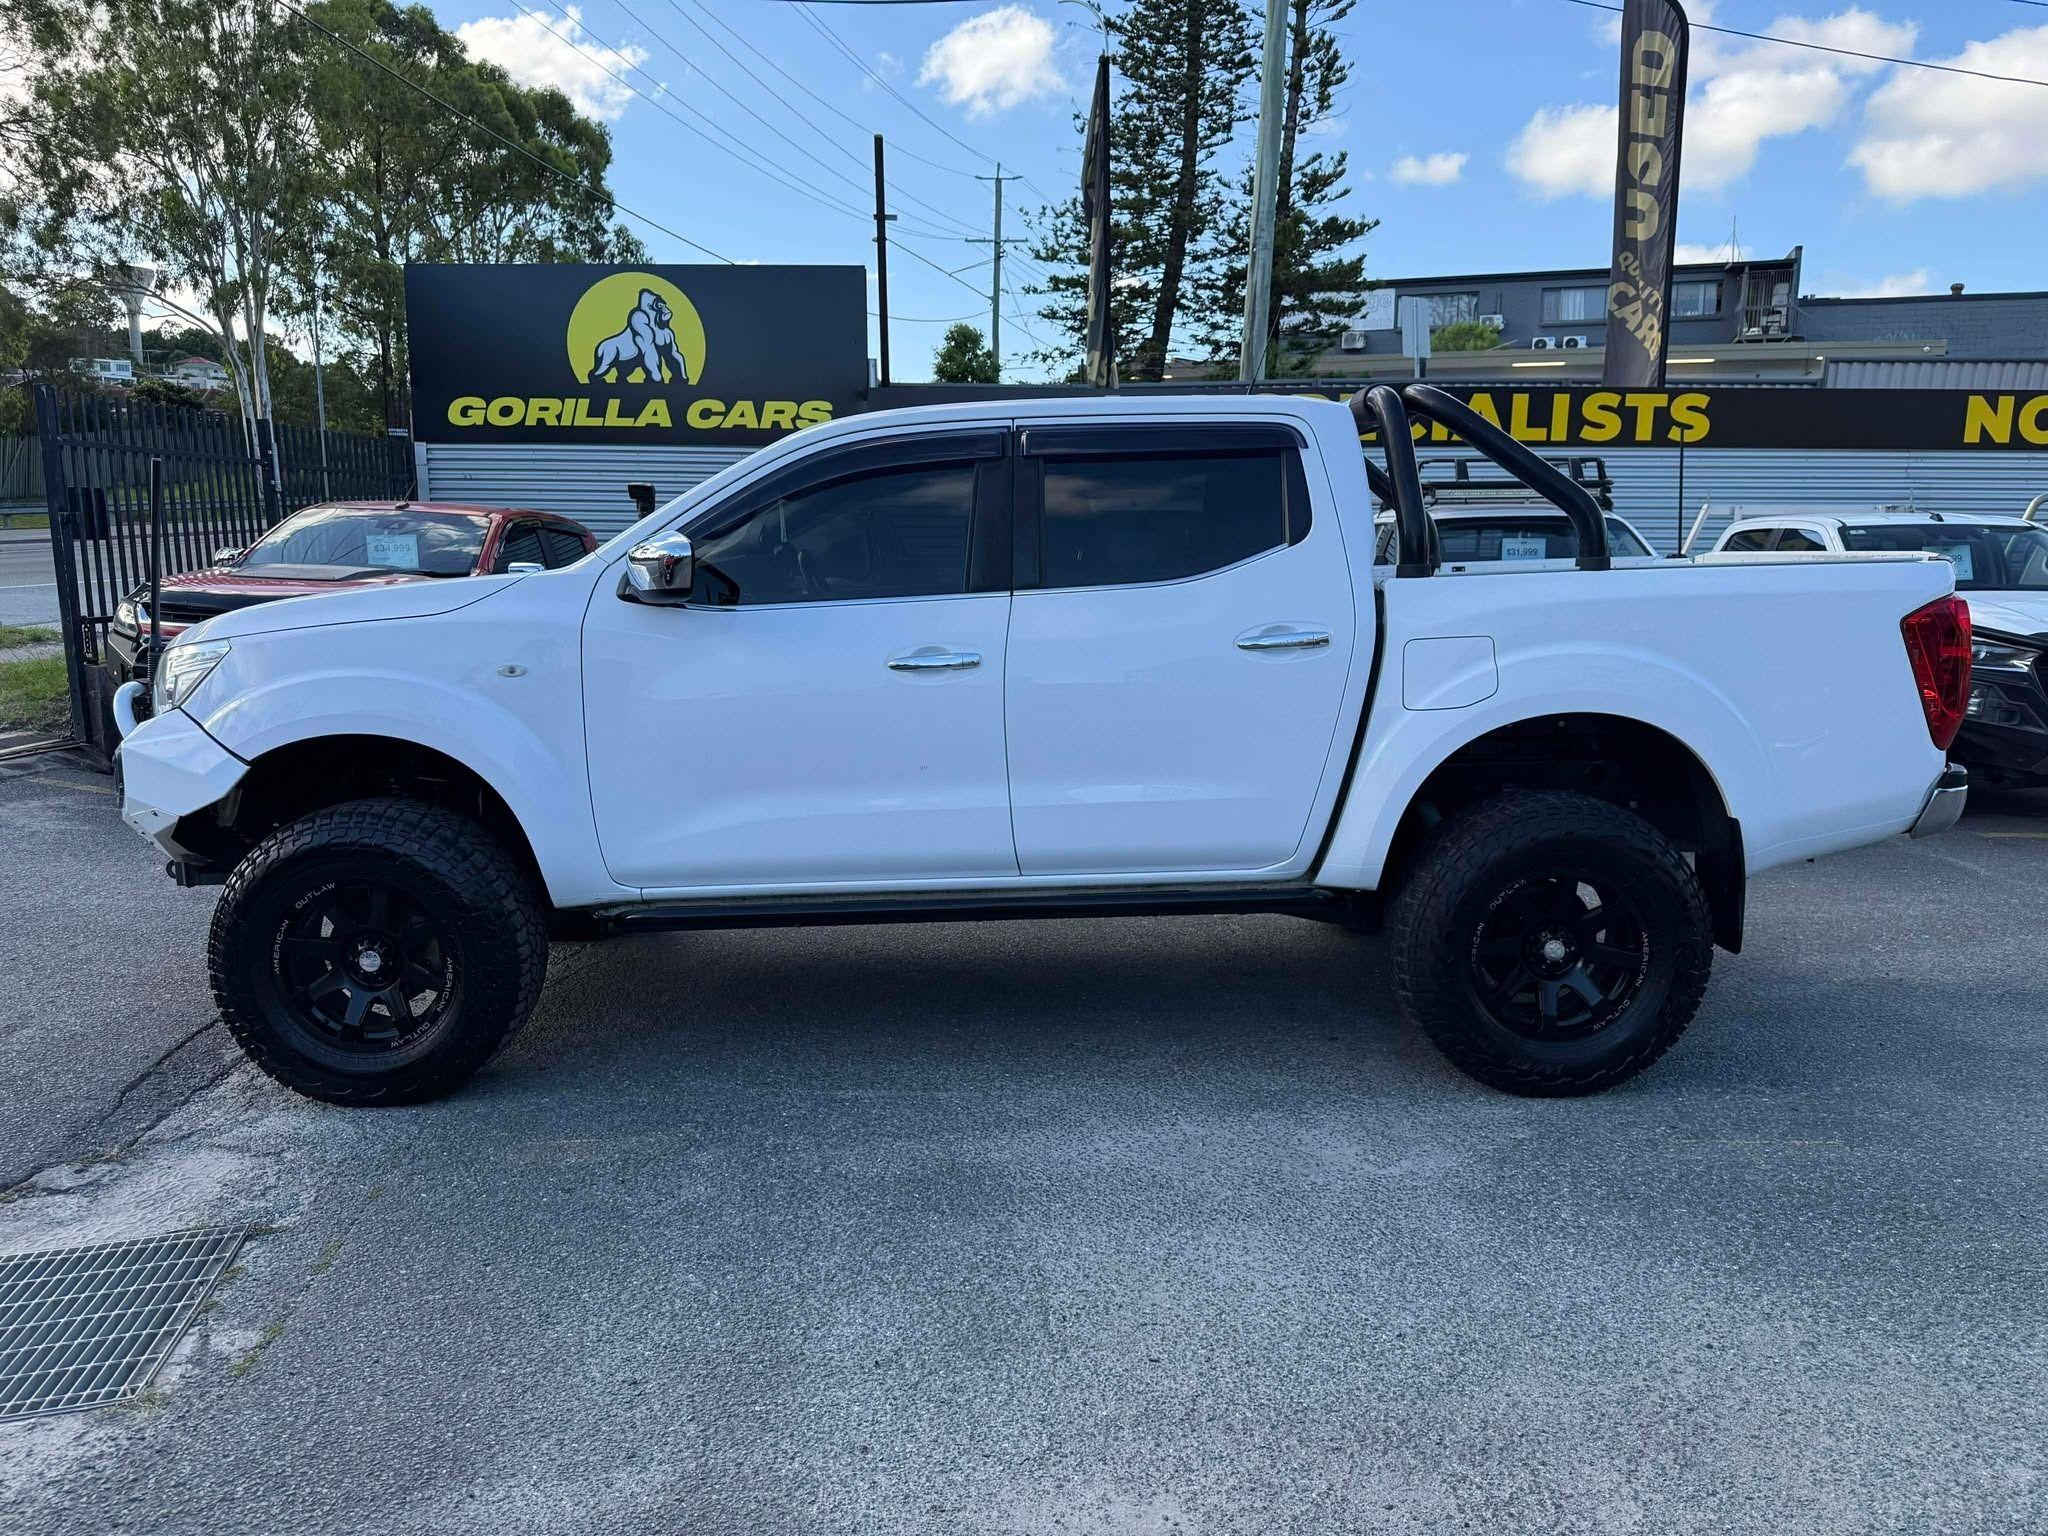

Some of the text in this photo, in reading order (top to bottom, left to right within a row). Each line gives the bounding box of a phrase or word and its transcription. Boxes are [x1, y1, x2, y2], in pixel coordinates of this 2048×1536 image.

[1626, 29, 1676, 241] USED
[447, 396, 834, 430] GORILLA CARS
[1506, 547, 1538, 558] $31,999
[273, 882, 336, 975] AMERICAN OUTLAW
[390, 956, 454, 1049] AMERICAN OUTLAW
[1592, 931, 1650, 1031] AMERICAN OUTLAW
